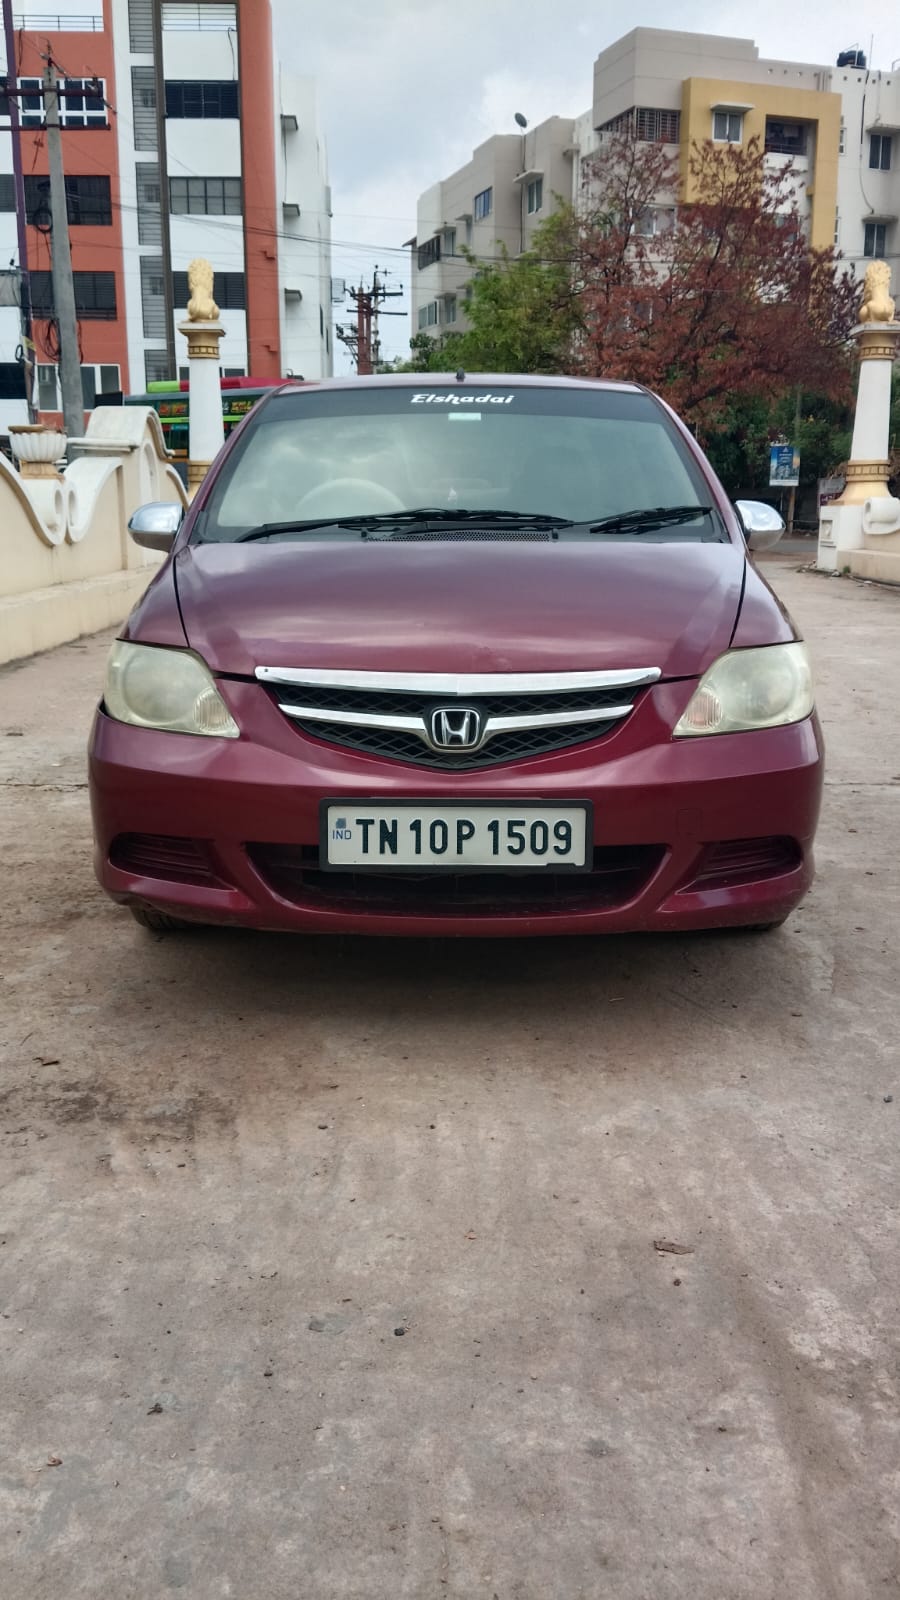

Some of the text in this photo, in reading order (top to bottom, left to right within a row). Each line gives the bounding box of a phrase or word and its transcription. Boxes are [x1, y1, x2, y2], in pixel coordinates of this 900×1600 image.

[410, 393, 515, 404] Elshadai
[332, 829, 352, 840] IND
[355, 819, 572, 855] TN 10 P 1509
